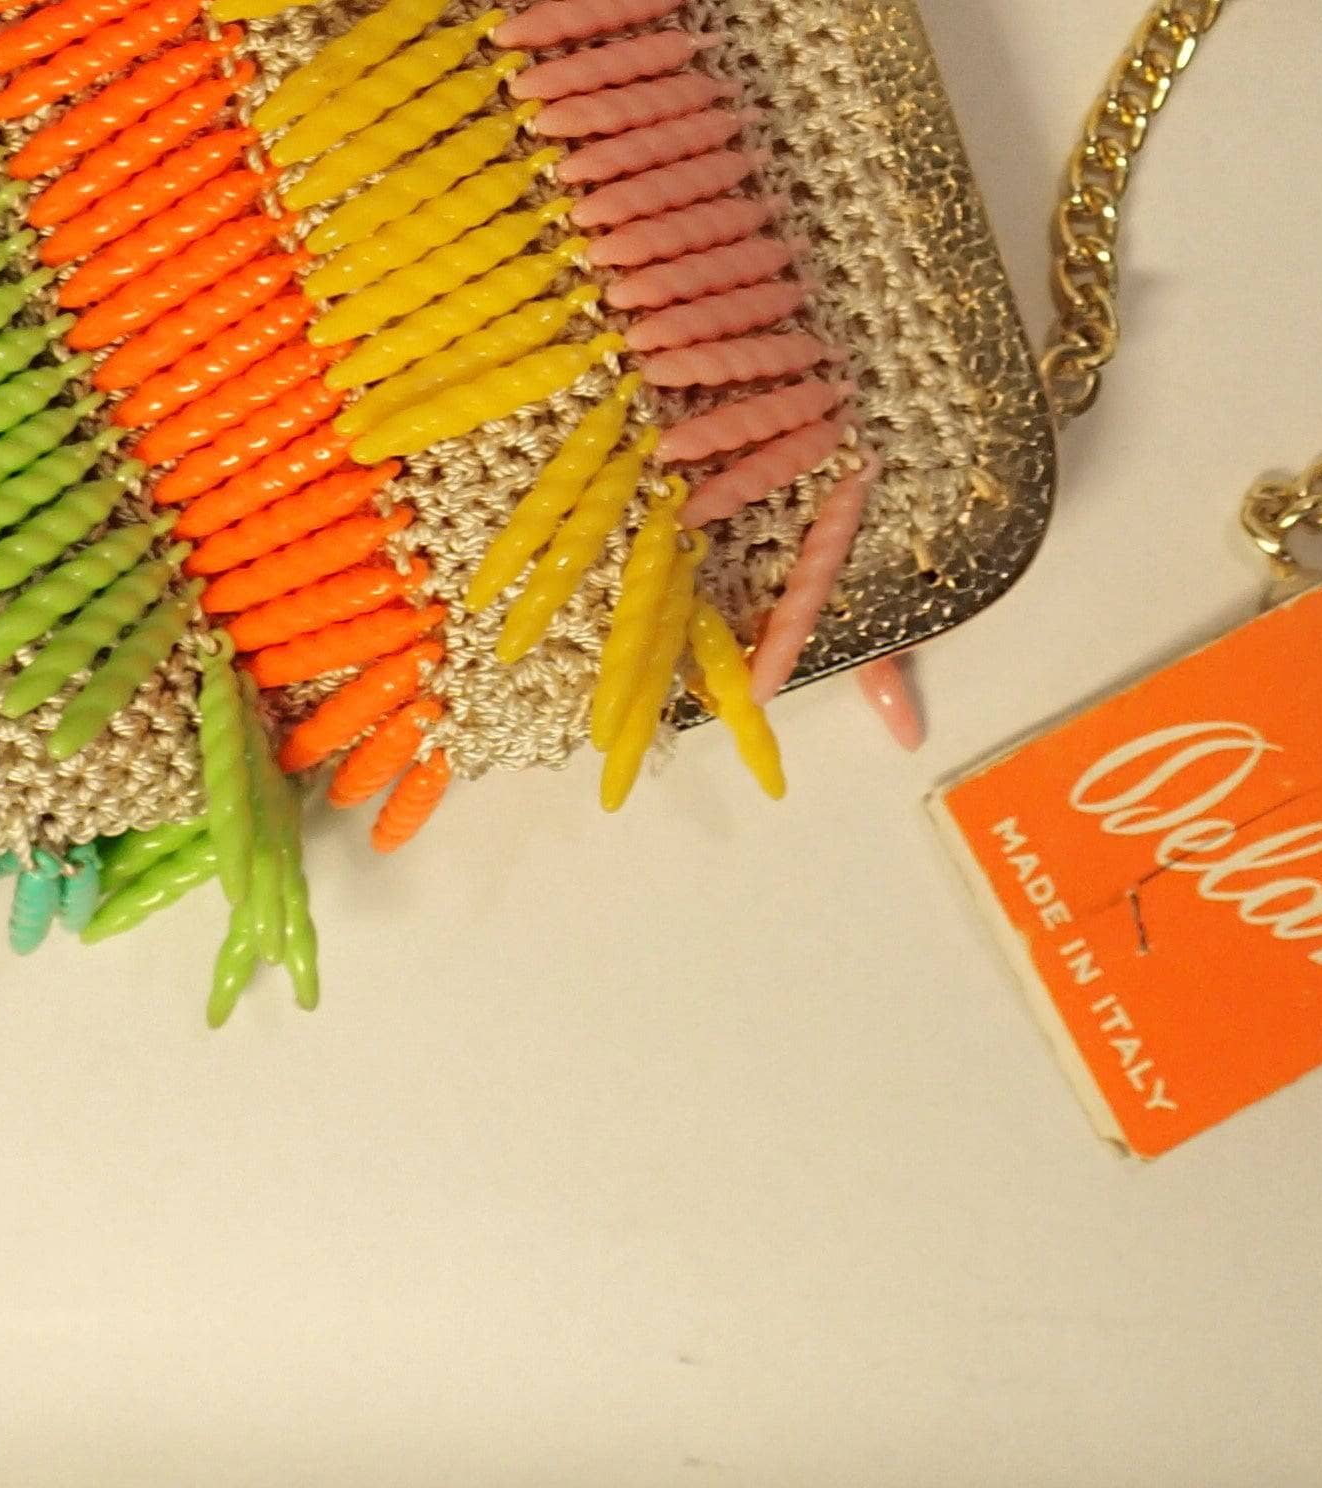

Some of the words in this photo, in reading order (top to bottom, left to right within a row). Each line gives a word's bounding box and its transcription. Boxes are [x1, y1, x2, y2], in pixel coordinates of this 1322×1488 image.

[990, 816, 1072, 930] MADE
[1059, 938, 1101, 985] IN
[1090, 994, 1178, 1113] ITALY
